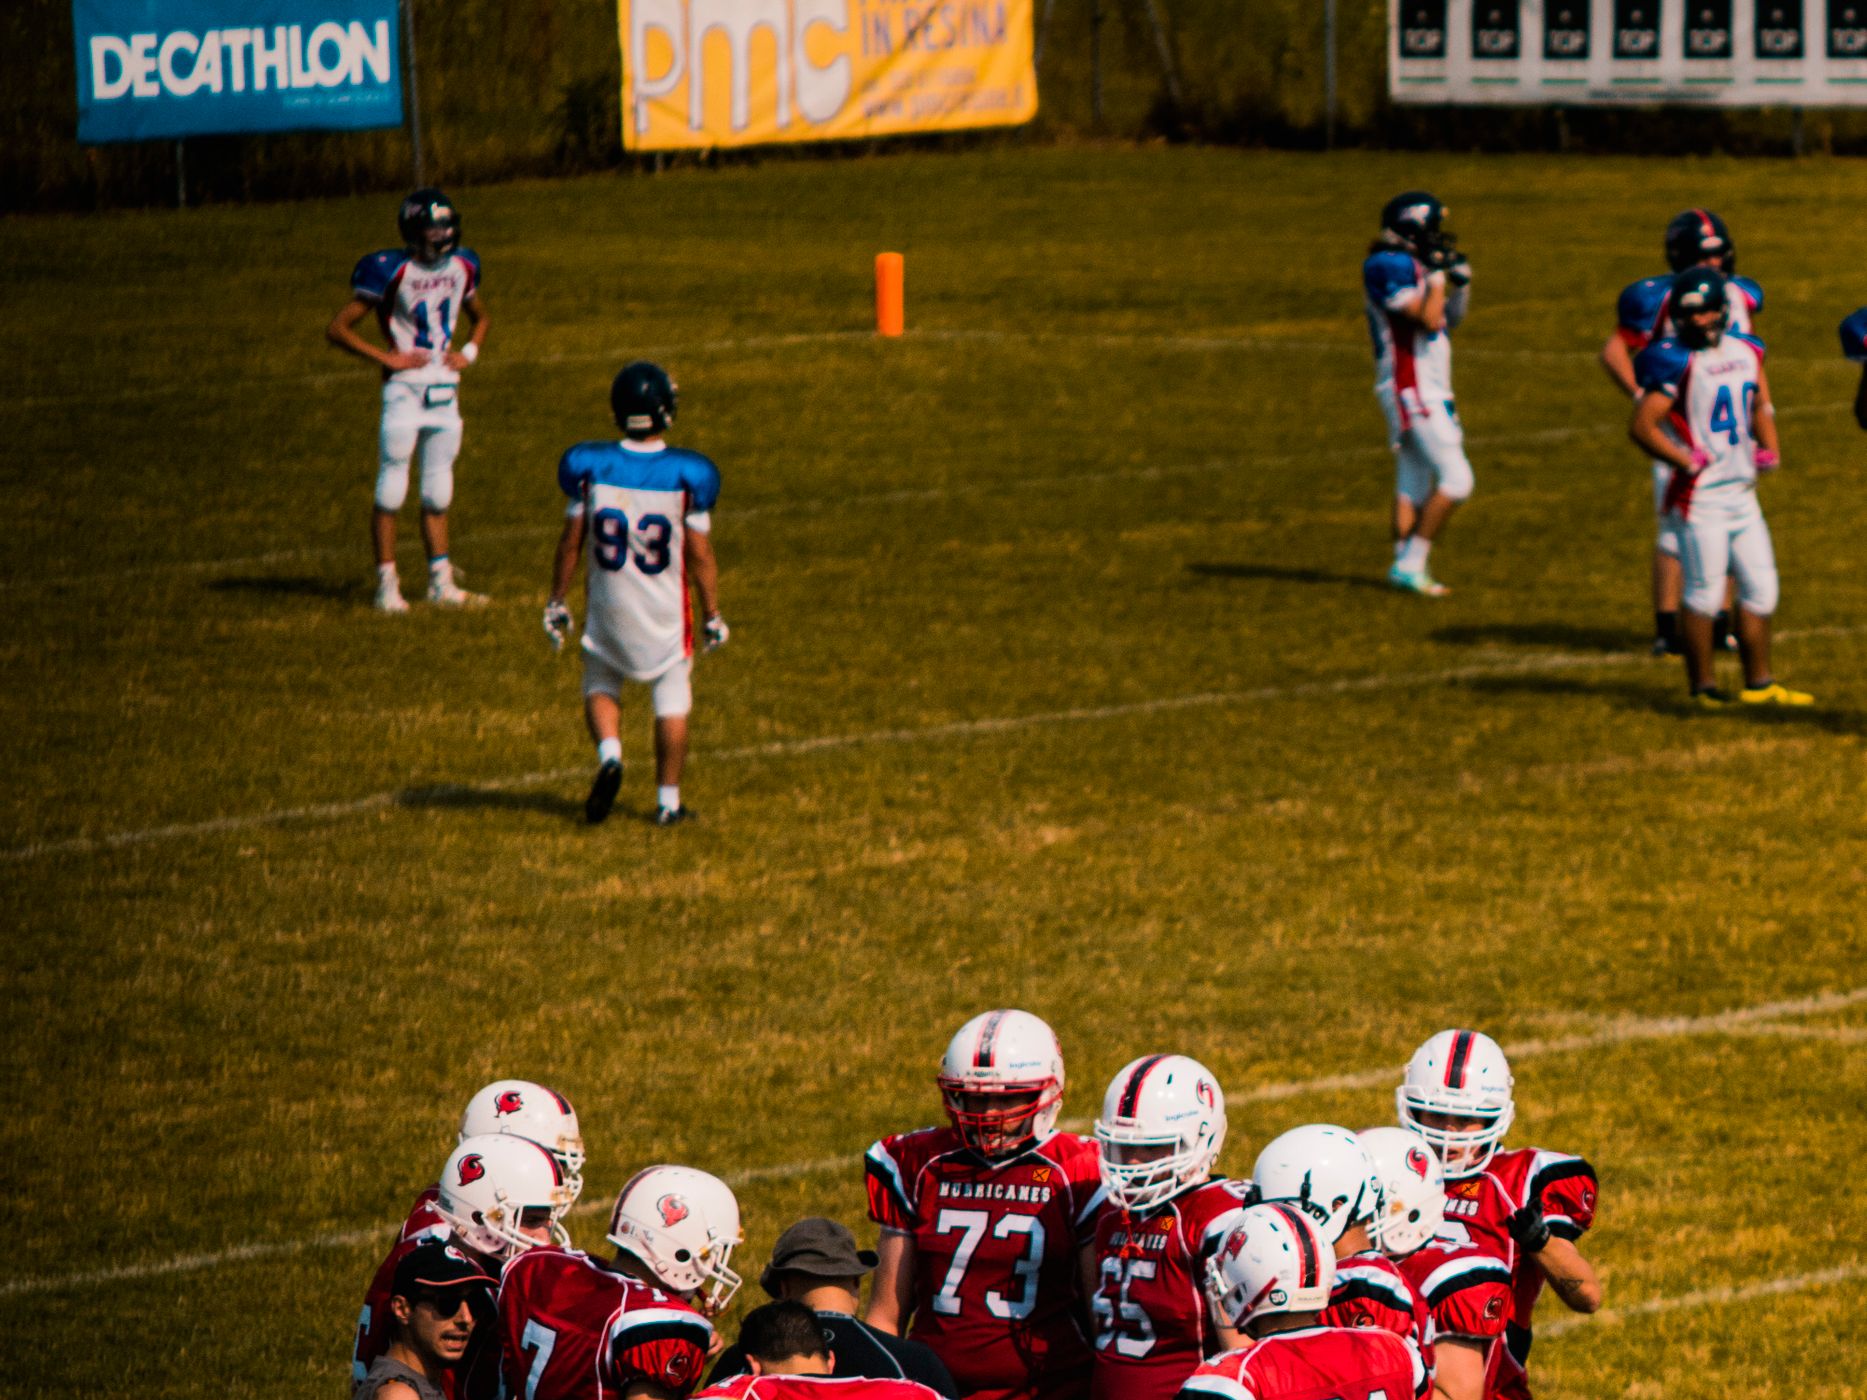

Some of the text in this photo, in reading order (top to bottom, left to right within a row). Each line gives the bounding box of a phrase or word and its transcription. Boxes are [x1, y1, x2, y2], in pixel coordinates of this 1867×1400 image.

[90, 20, 390, 99] DECATHLON
[412, 297, 453, 351] 11
[594, 507, 673, 575] 93
[939, 1181, 1051, 1203] HURRICANES
[932, 1208, 1046, 1320] 73
